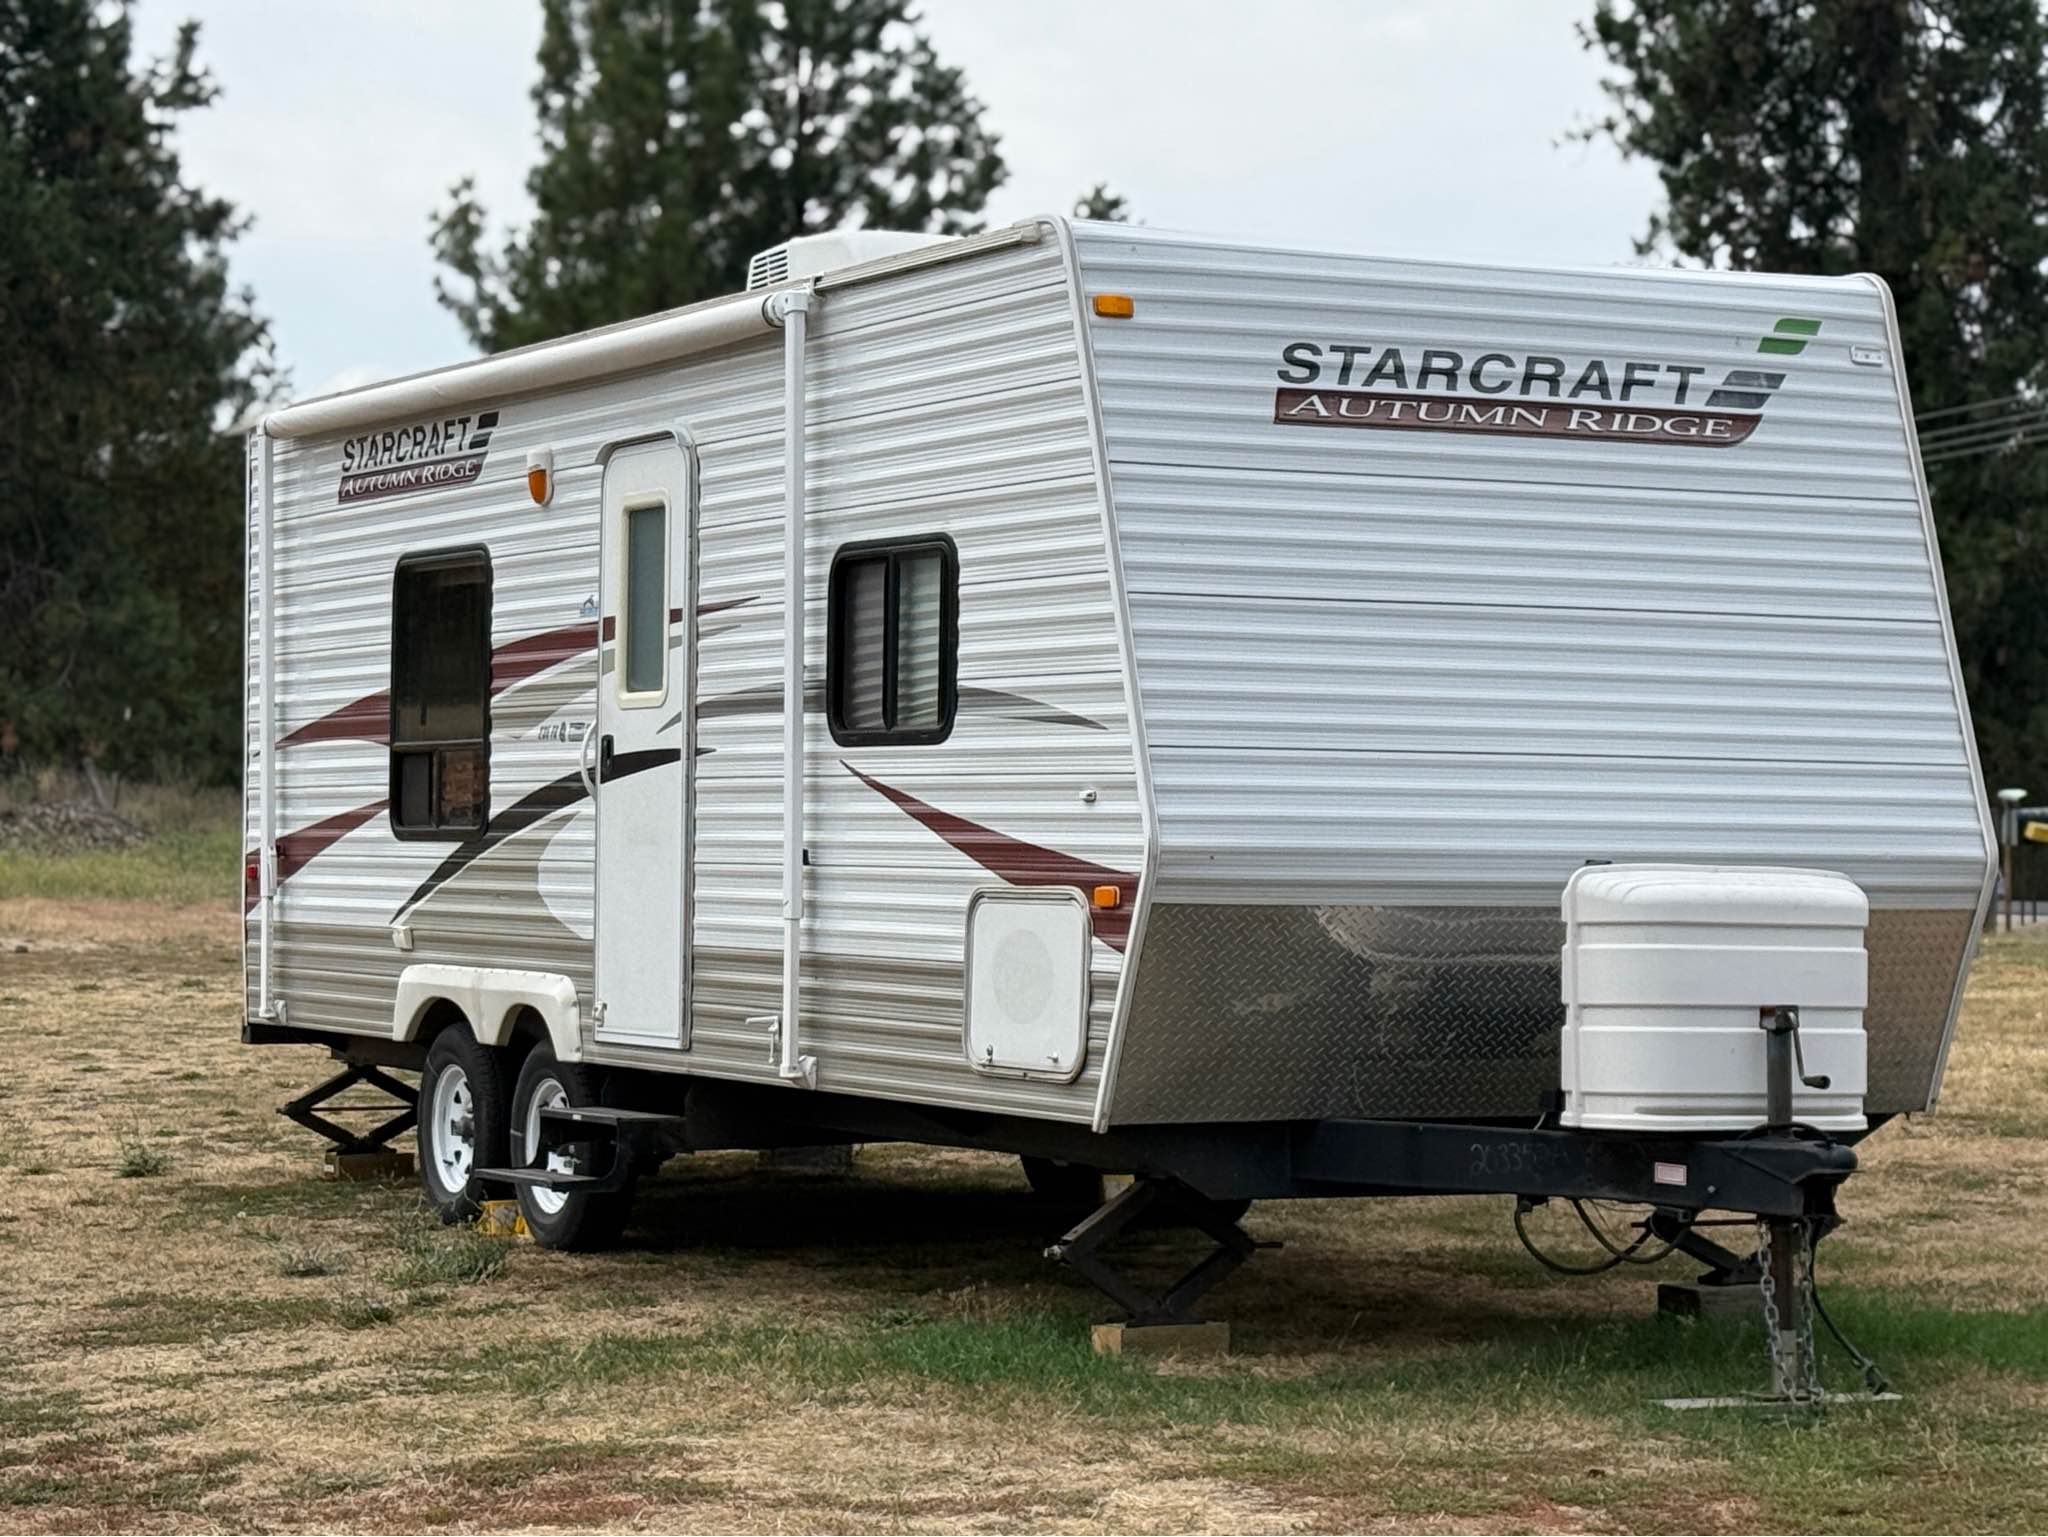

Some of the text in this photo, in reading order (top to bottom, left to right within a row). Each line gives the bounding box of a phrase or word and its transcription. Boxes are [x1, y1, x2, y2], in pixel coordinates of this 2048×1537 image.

[1277, 342, 1705, 405] STARCRAFT
[1285, 394, 1734, 438] AUTUMN RIDGE
[342, 416, 471, 472] STARCRAFT
[341, 459, 477, 497] AUTUMN RIDGE
